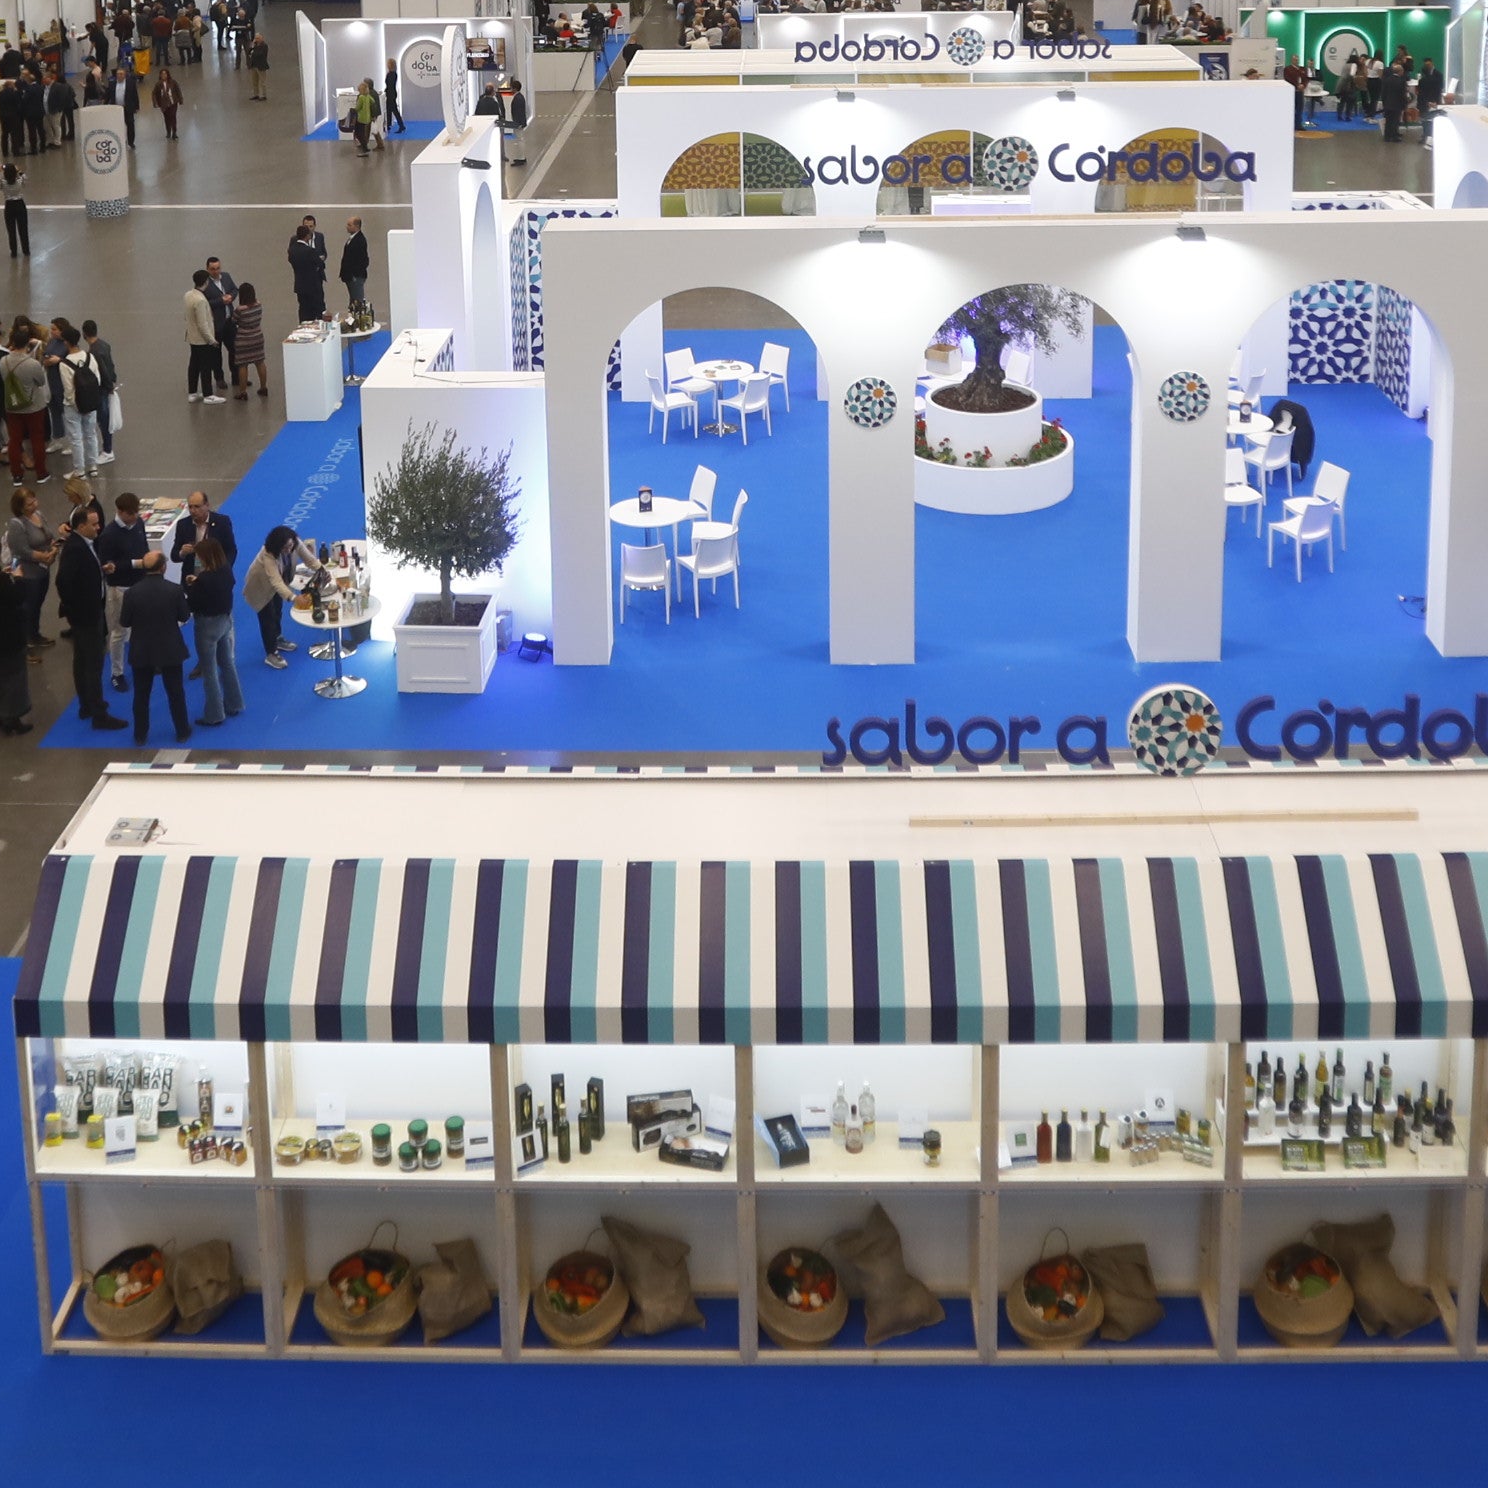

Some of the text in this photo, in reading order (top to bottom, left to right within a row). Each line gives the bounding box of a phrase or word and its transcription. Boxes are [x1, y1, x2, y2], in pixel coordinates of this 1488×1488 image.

[802, 145, 931, 186] sabor
[941, 155, 973, 185] a
[821, 699, 1040, 766] sabor
[1056, 715, 1109, 765] a
